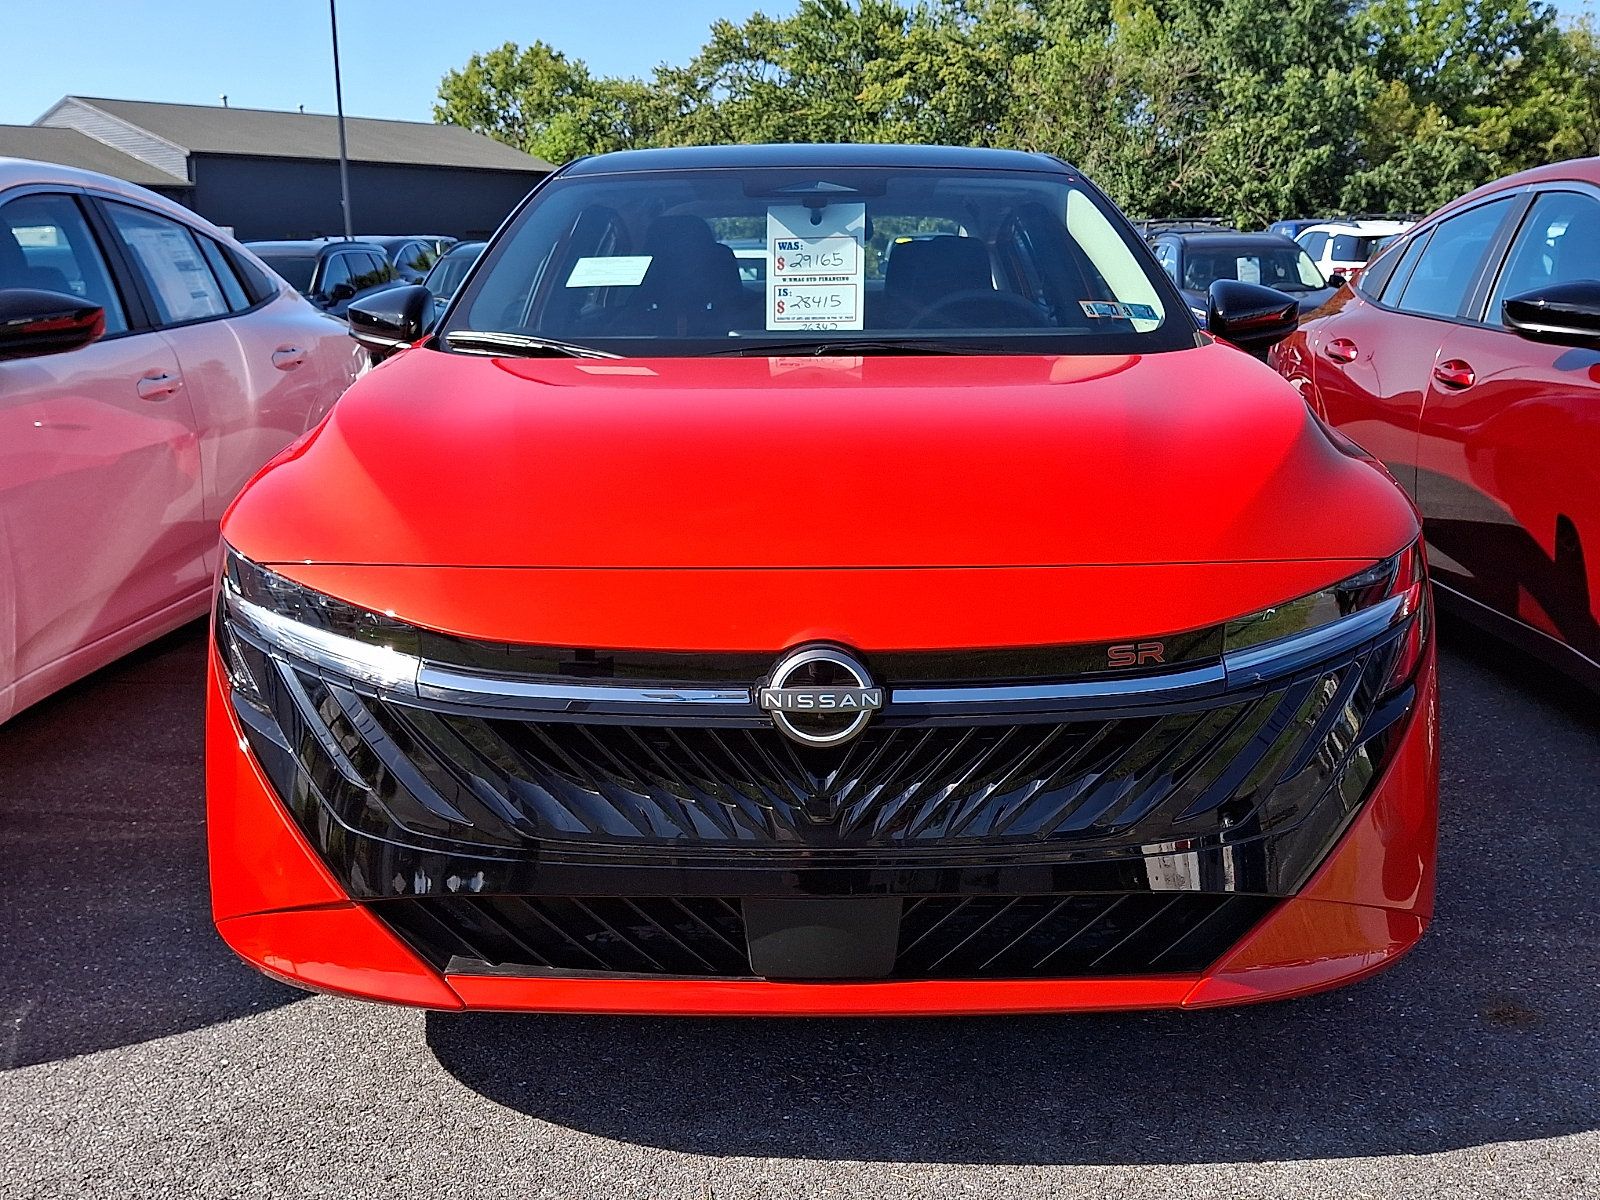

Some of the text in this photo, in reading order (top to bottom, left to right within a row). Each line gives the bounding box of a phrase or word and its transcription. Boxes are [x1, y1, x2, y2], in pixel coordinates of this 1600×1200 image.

[778, 241, 804, 251] WAS:
[777, 252, 844, 271] $ 29165
[777, 288, 793, 297] IS:
[777, 294, 842, 315] $ 28415
[1107, 641, 1166, 667] SR
[765, 692, 879, 709] NISSAN
